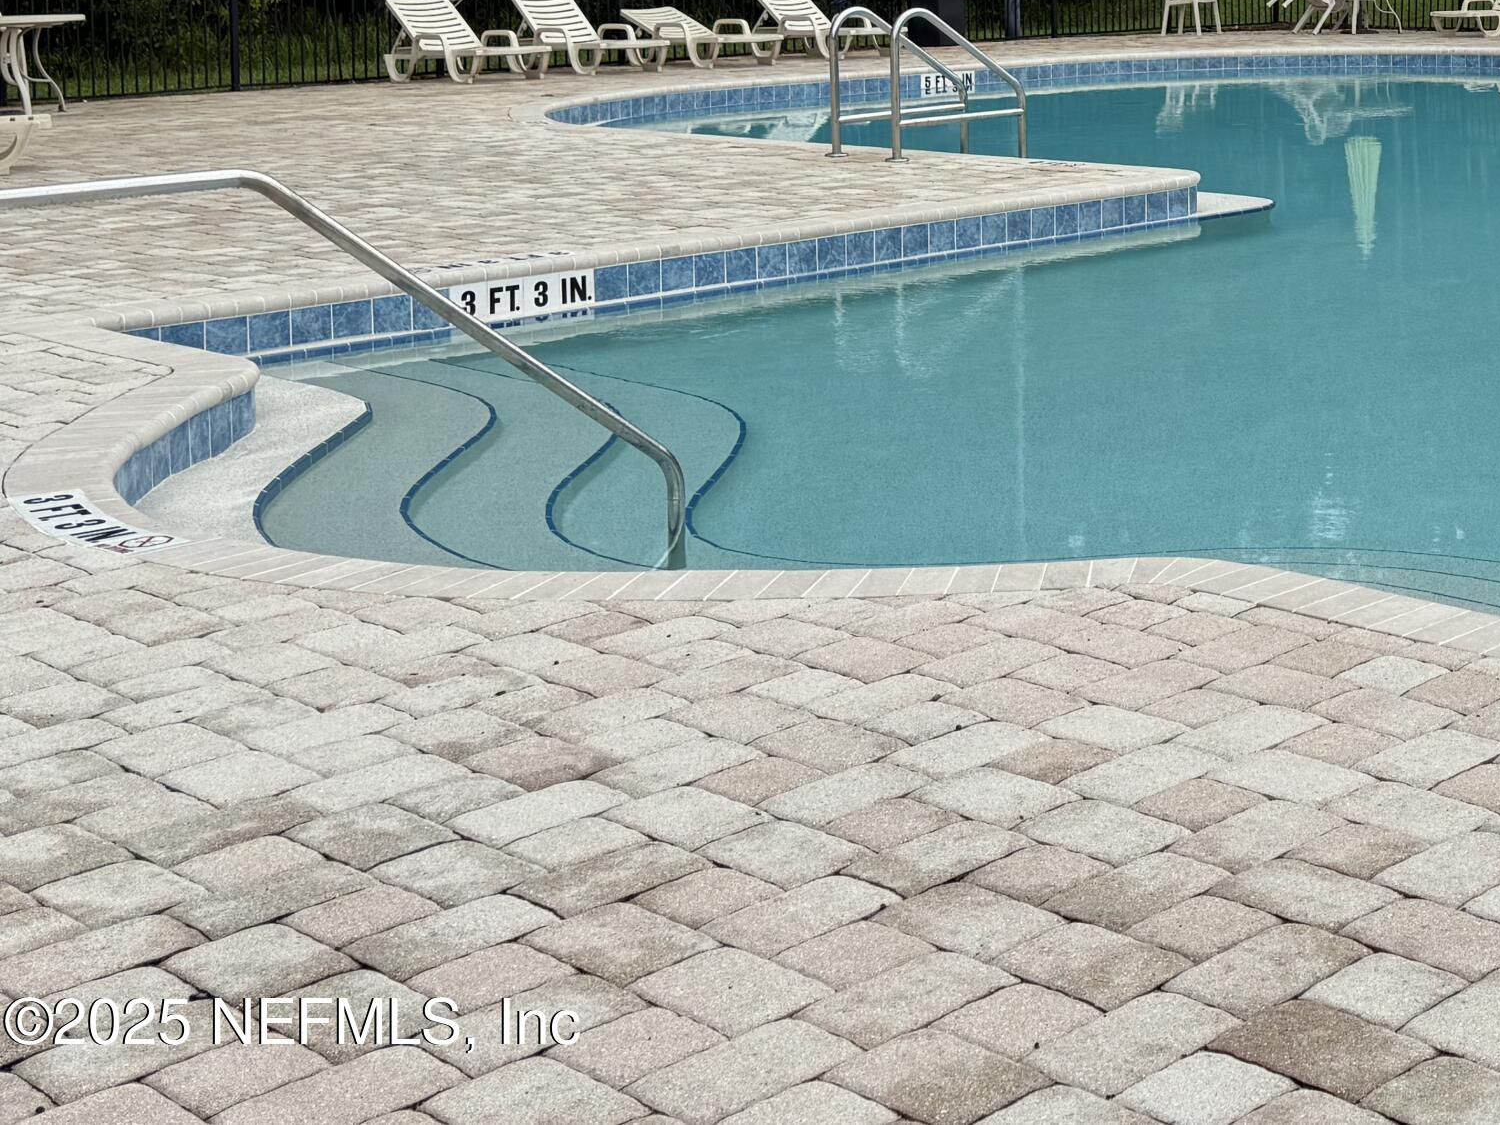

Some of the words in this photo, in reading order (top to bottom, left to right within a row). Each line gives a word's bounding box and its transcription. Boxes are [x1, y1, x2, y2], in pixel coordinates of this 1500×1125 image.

[925, 76, 931, 88] 5
[461, 290, 476, 316] 3
[489, 284, 521, 315] FT.
[534, 280, 548, 308] 3
[561, 275, 592, 305] IN.
[23, 494, 74, 505] 3
[29, 503, 92, 522] FT.
[54, 518, 107, 530] 3
[70, 526, 138, 544] IN.
